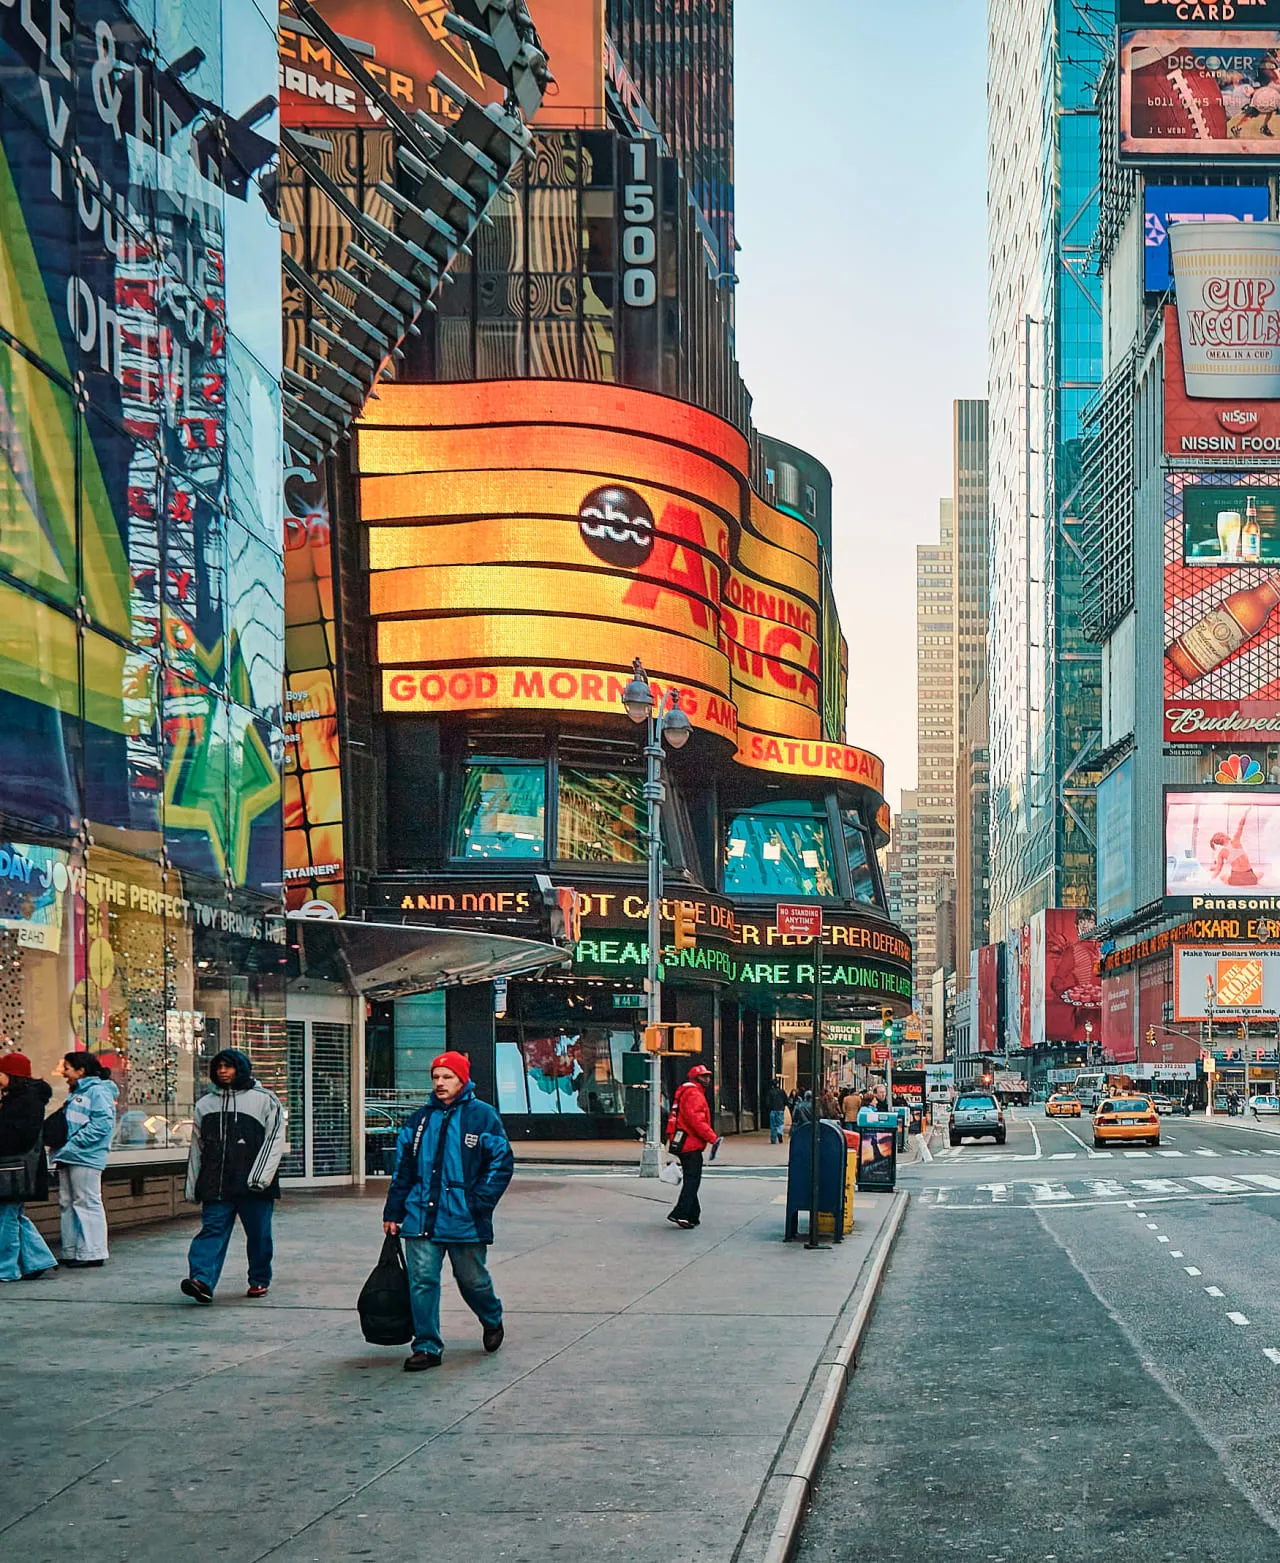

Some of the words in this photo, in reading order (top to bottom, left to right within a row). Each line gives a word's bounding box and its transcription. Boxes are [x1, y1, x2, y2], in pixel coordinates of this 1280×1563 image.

[1176, 4, 1235, 20] CARD
[1167, 55, 1253, 70] DISCOVER
[623, 143, 656, 307] 1500
[1203, 277, 1275, 311] CUP
[1209, 351, 1233, 359] MEAL
[1234, 351, 1243, 359] IN
[1254, 350, 1270, 358] CUP
[1222, 409, 1258, 425] NISSIN
[1181, 436, 1236, 451] NISSIN
[581, 503, 653, 546] abc
[390, 672, 498, 701] GOOD
[286, 690, 308, 701] Boys
[285, 709, 320, 722] Rejects
[40, 859, 86, 897] JOY!
[94, 873, 127, 906] THE
[130, 885, 190, 921] PERFECT
[194, 902, 219, 927] TOY
[780, 909, 788, 917] NO
[791, 909, 819, 917] STANDING
[784, 917, 814, 925] ANYTIME
[739, 963, 790, 984] ARE
[797, 964, 878, 988] READING
[879, 972, 895, 991] THE
[1217, 960, 1263, 1004] HOME
[1222, 964, 1241, 983] THE
[1235, 978, 1263, 1006] DEPOT
[827, 1026, 861, 1034] RBUCKS
